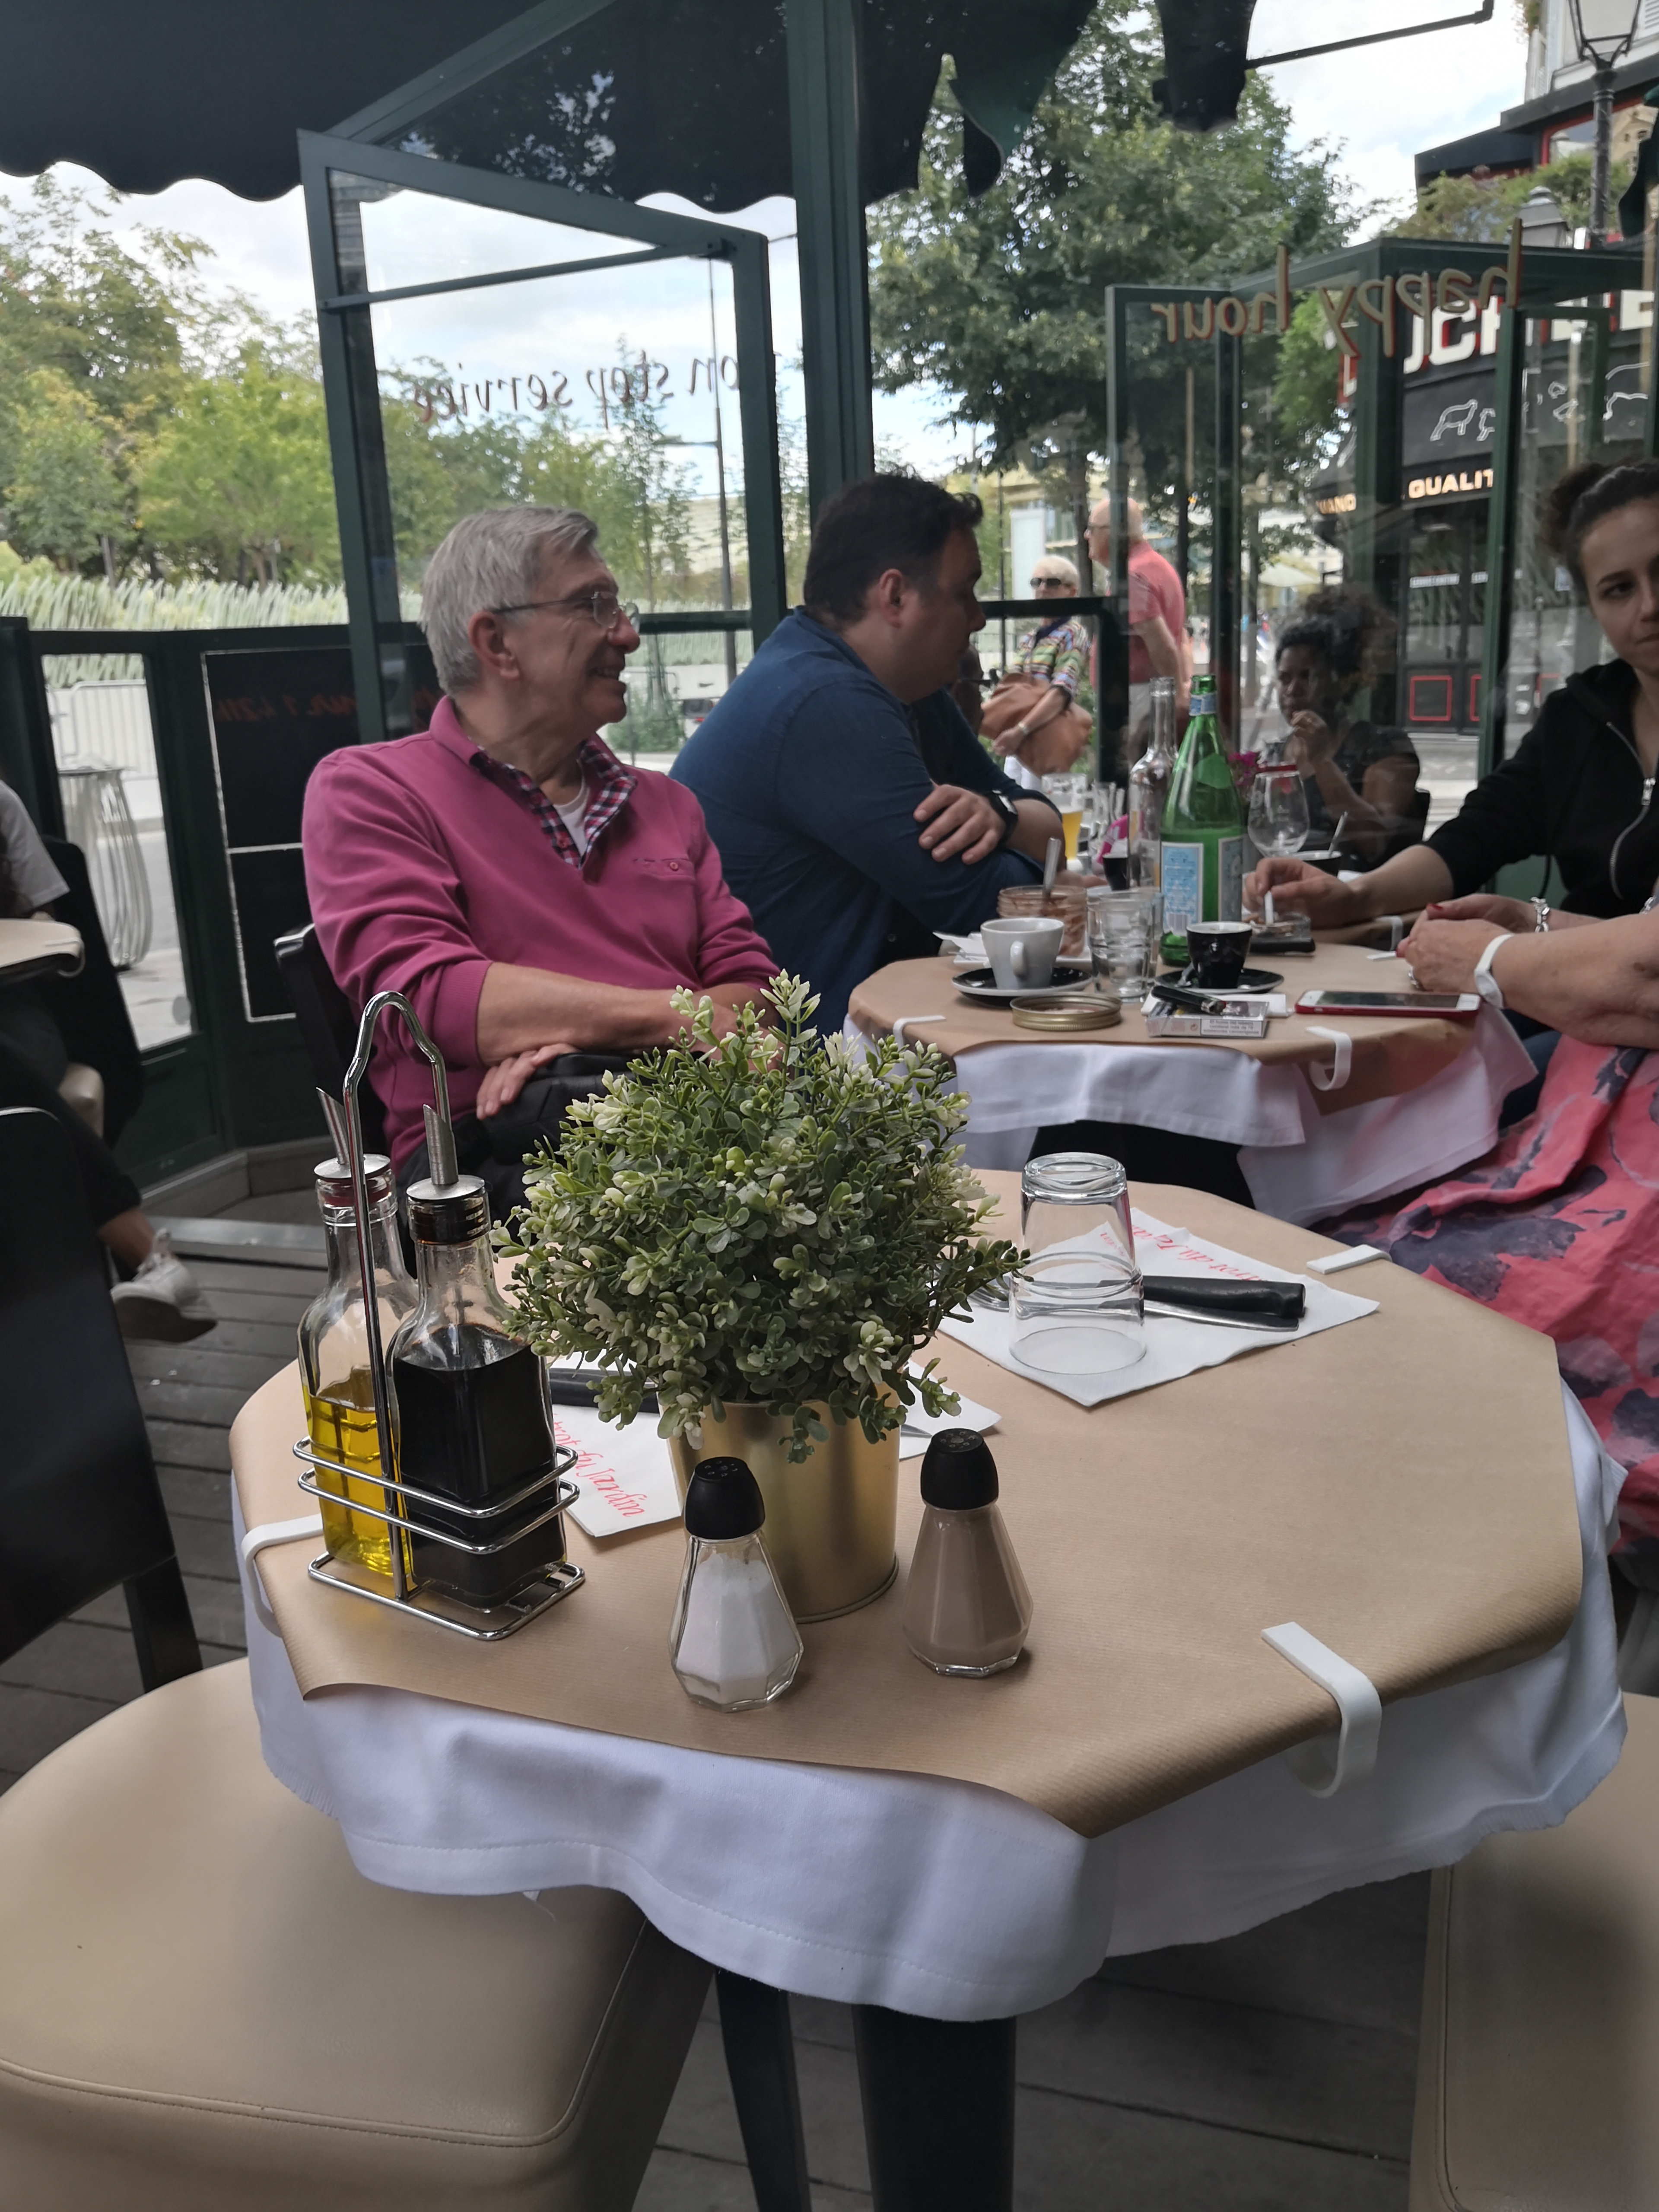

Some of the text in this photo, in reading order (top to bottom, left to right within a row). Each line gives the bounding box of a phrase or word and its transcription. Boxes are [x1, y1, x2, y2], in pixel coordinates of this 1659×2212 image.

[1408, 468, 1494, 499] QUALIT
[1177, 1249, 1214, 1262] du
[575, 1468, 648, 1518] Jardin
